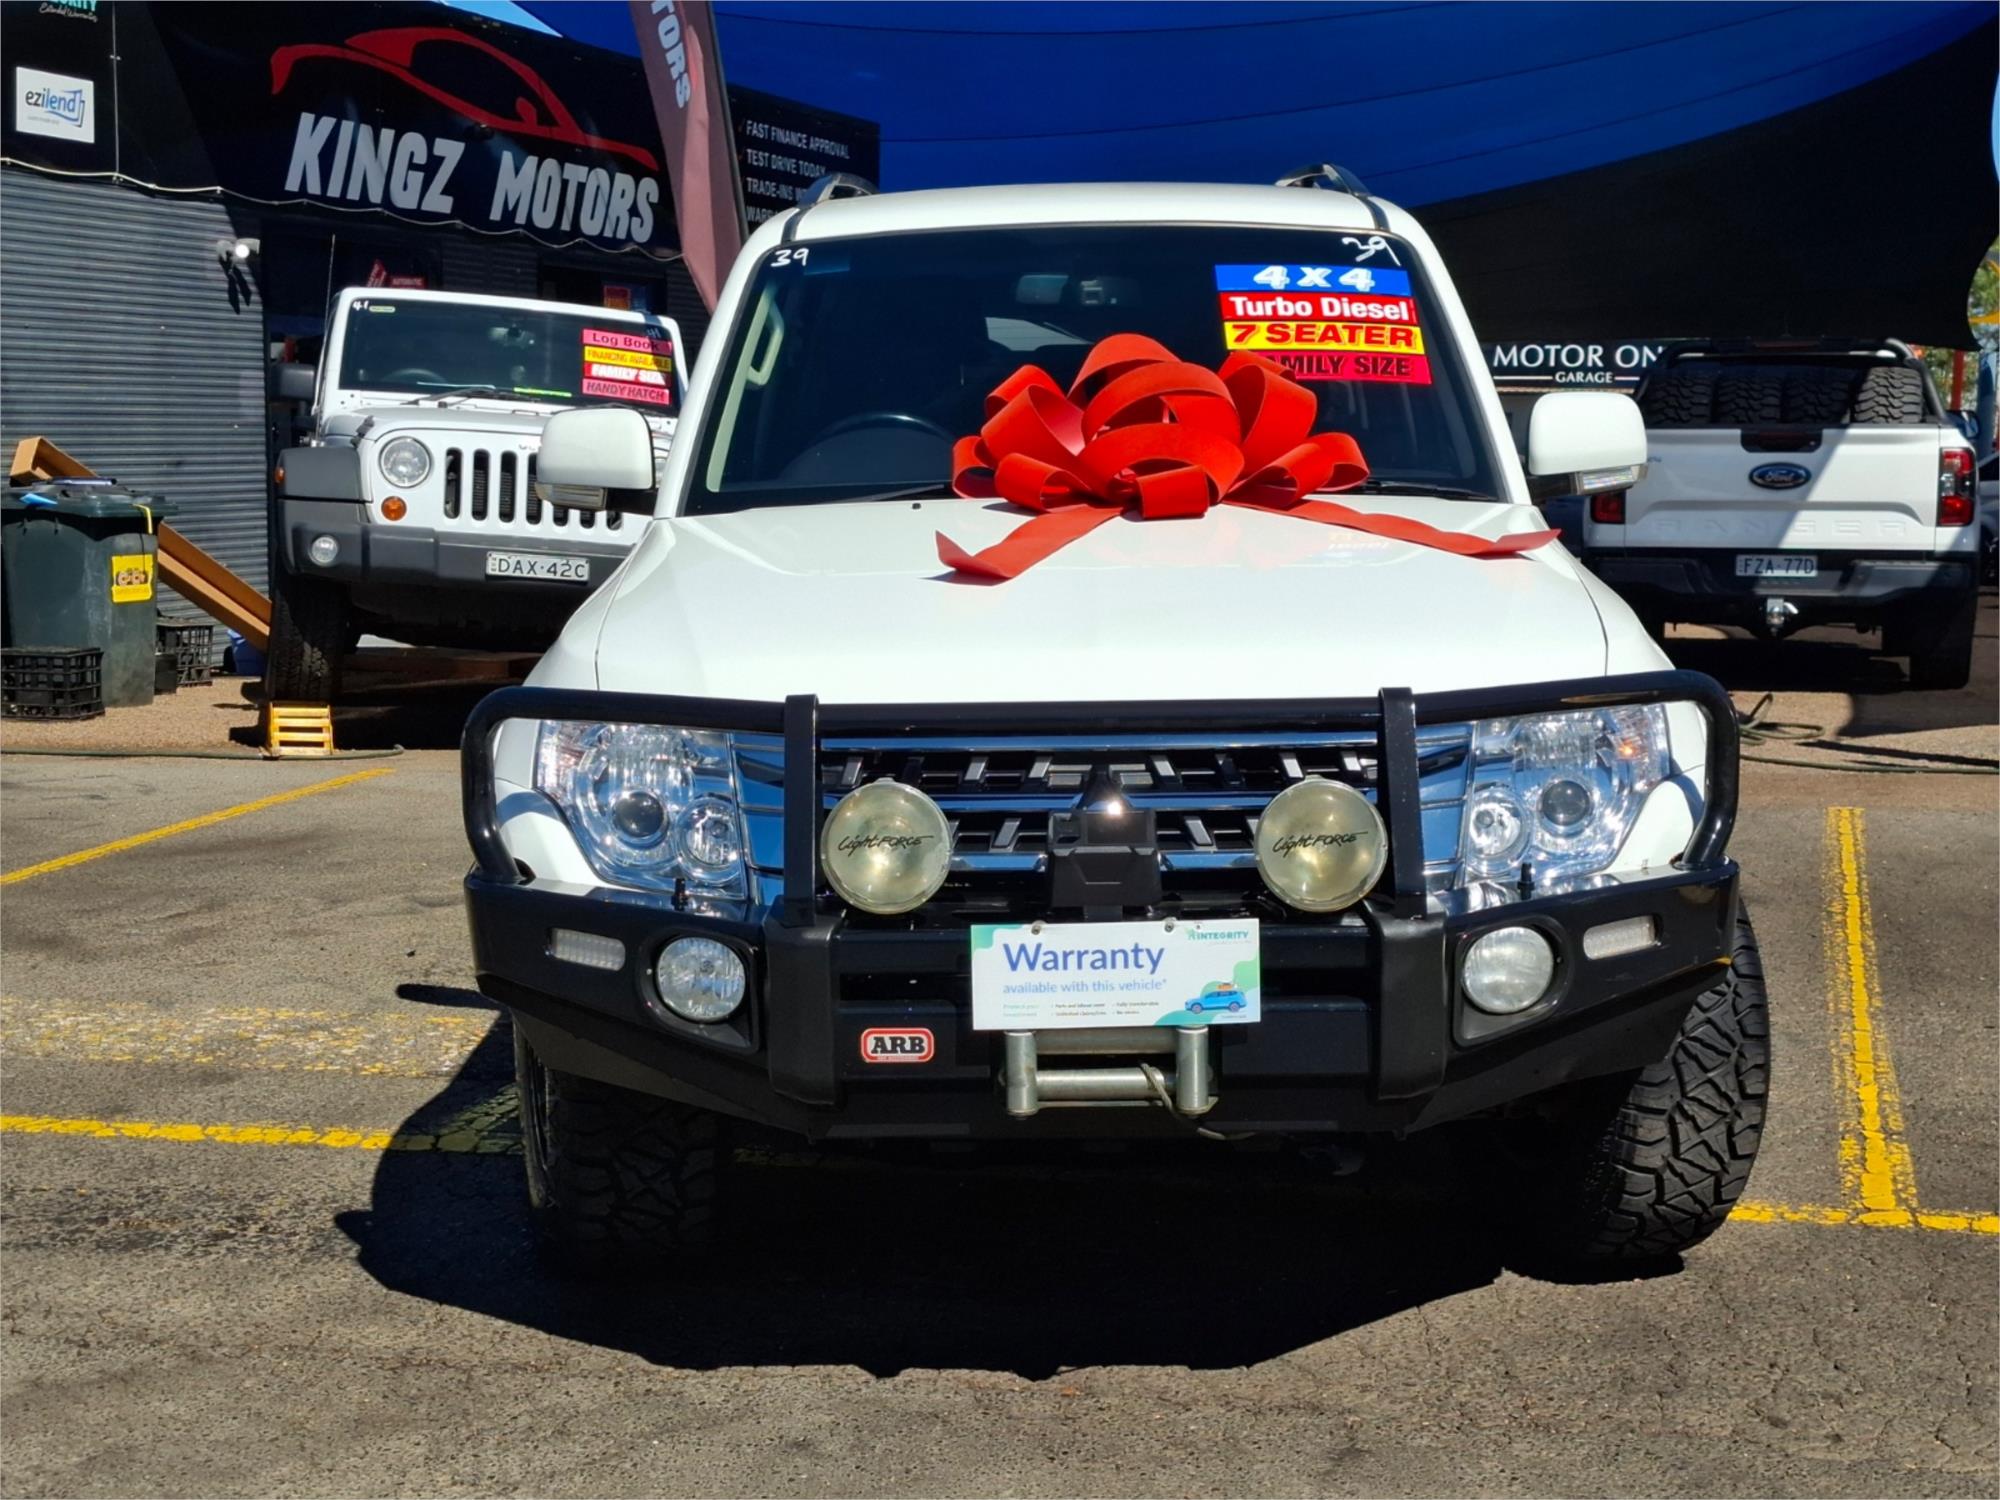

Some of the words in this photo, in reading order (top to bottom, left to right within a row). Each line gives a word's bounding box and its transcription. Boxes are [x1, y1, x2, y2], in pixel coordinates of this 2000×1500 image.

[25, 87, 76, 113] ezilend
[746, 120, 769, 139] FAST
[771, 126, 808, 149] FINANCE
[809, 136, 850, 160] APPROVAL
[746, 148, 769, 167] TEST
[771, 154, 797, 174] DRIVE
[799, 160, 826, 178] TODAY
[284, 112, 466, 214] KINGZ
[489, 151, 660, 243] MOTORS
[746, 177, 793, 200] TRADE-INS
[746, 205, 778, 223] WARR
[770, 248, 809, 267] 39
[1229, 296, 1313, 317] Turbo
[1320, 297, 1409, 321] Diesel
[592, 333, 618, 346] Log
[623, 338, 658, 351] Book
[1232, 324, 1259, 344] 7
[1266, 323, 1415, 347] SEATER
[1268, 354, 1346, 375] MILY
[1354, 357, 1412, 376] SIZE
[1493, 344, 1604, 368] MOTOR
[1555, 371, 1613, 384] GARAGE
[586, 382, 627, 398] HANDY
[627, 387, 665, 401] HATCH
[1655, 519, 1906, 537] RANGER
[1196, 931, 1249, 940] INTEGRITY
[1003, 942, 1165, 975] Warranty
[1003, 982, 1058, 995] available
[1060, 980, 1089, 993] with
[1092, 979, 1115, 992] this
[870, 1036, 926, 1054] ARB
